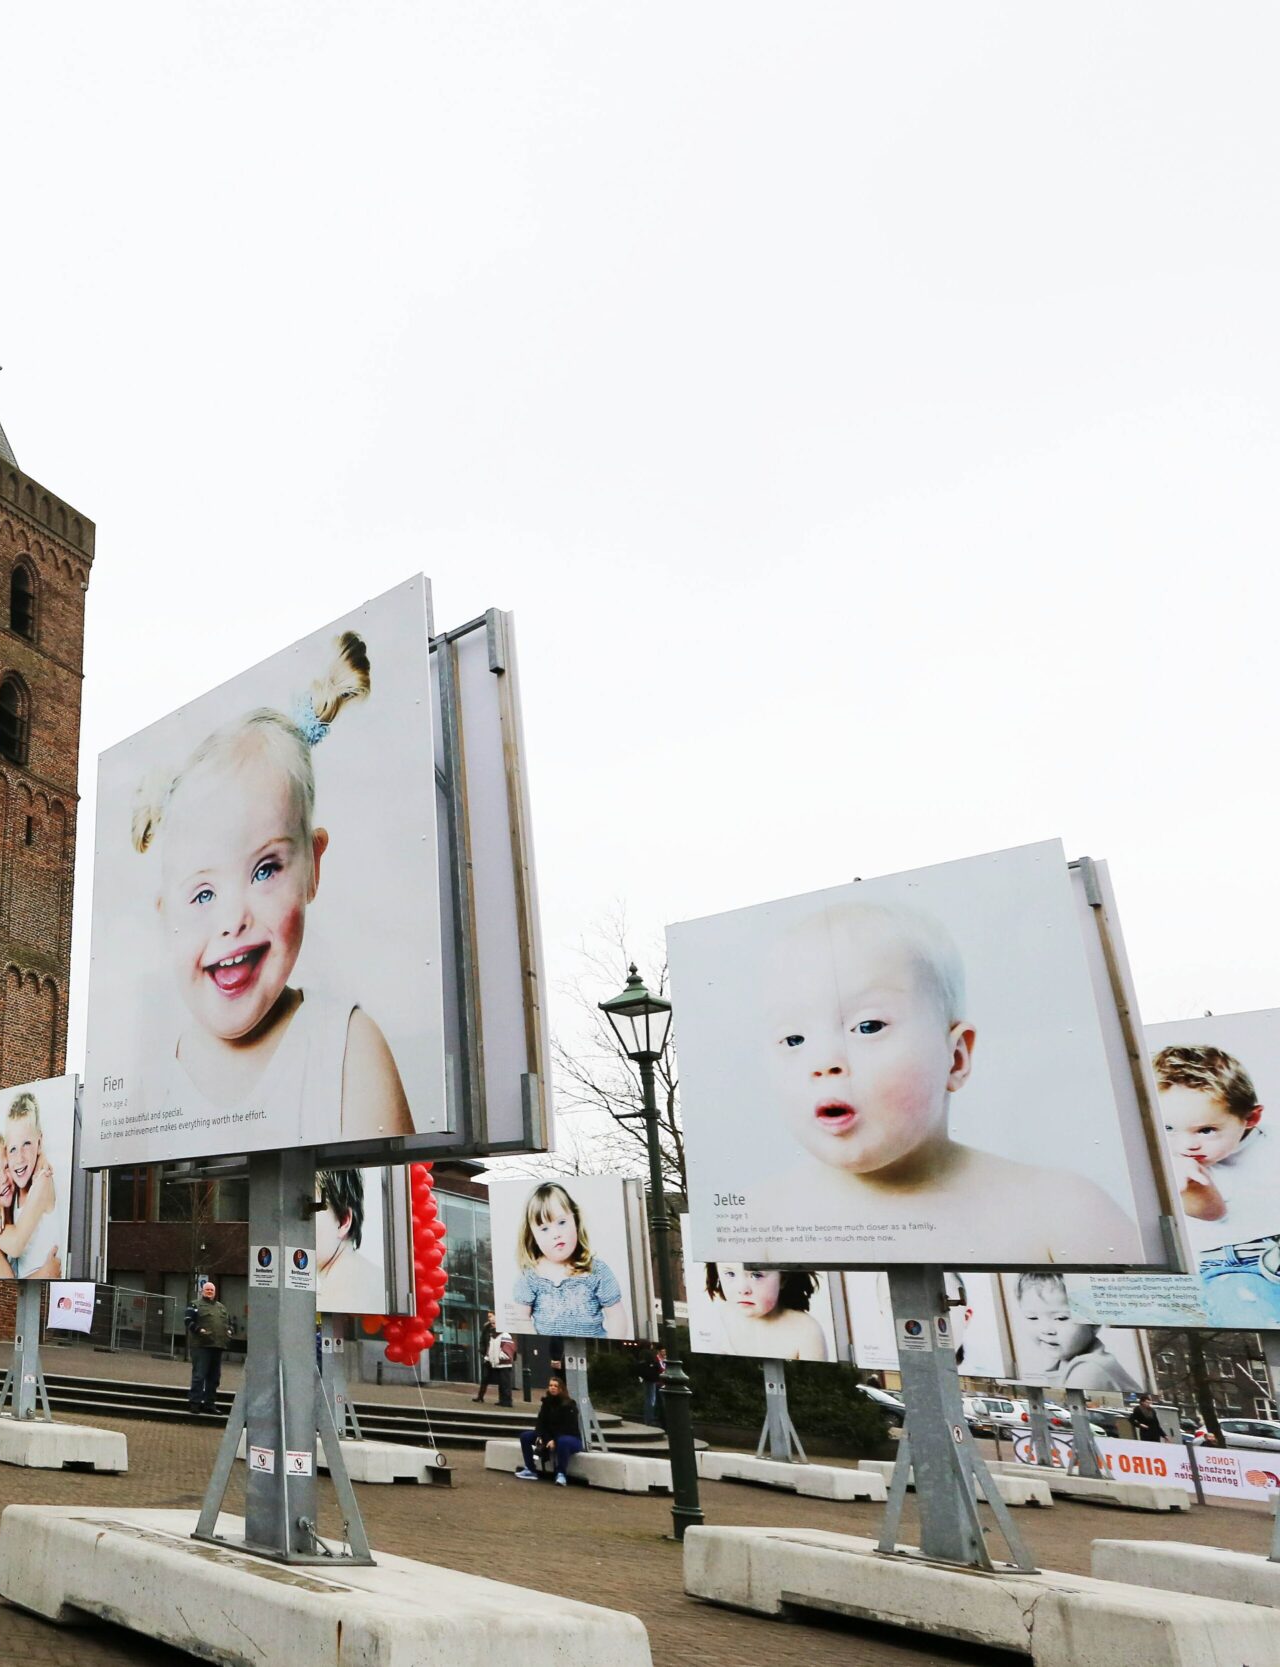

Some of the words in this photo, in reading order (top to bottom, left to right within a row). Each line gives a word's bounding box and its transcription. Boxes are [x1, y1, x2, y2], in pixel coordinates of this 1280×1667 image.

[103, 1076, 123, 1093] Fien
[113, 1101, 123, 1110] age
[100, 1131, 112, 1140] Each
[125, 1125, 158, 1136] achievement
[160, 1123, 177, 1131] makes
[179, 1118, 210, 1130] everything
[212, 1114, 230, 1125] worth
[232, 1113, 243, 1122] the
[245, 1110, 267, 1121] effort.
[101, 1118, 111, 1126] Fien
[113, 1117, 117, 1125] is
[125, 1112, 149, 1124] beautiful
[151, 1110, 160, 1120] and
[714, 1193, 746, 1206] Jelte
[908, 1222, 936, 1231] family.
